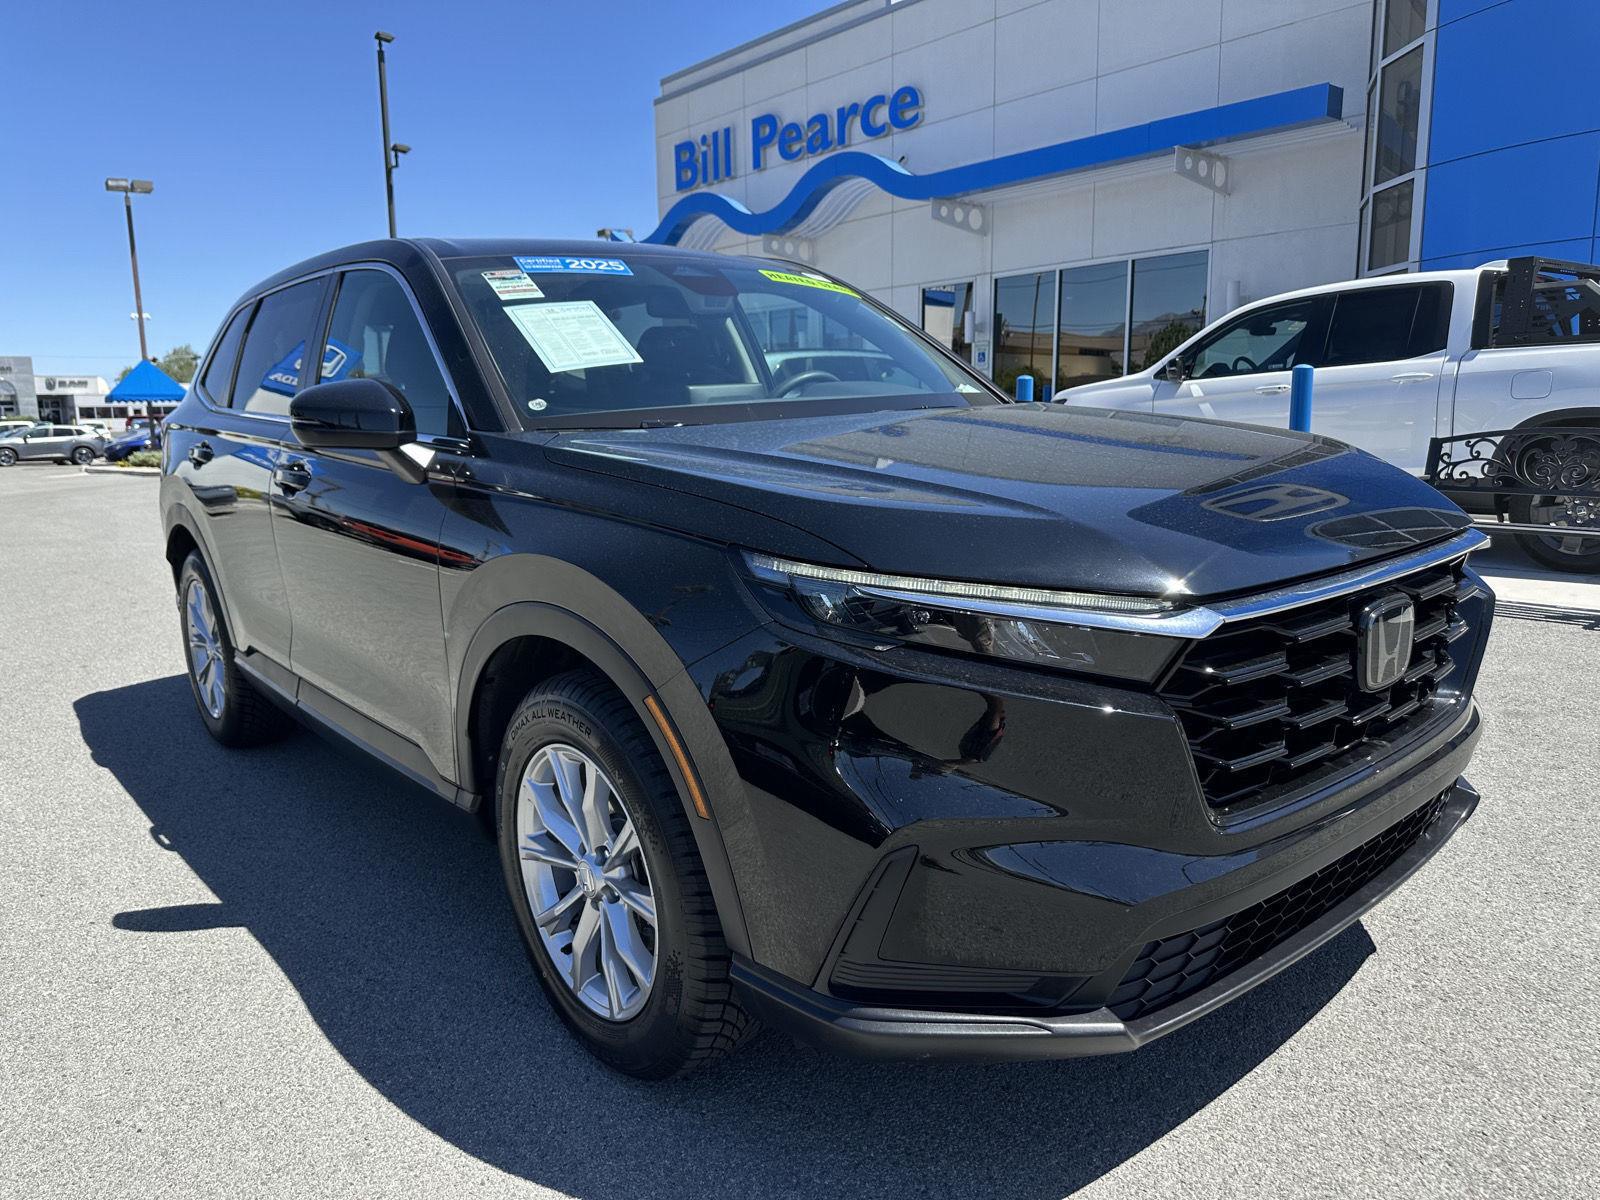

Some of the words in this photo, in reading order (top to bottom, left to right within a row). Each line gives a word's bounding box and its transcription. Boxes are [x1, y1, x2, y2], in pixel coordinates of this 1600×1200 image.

[674, 126, 734, 192] Bill
[752, 85, 921, 171] Pearce
[565, 258, 625, 271] 2025
[510, 713, 533, 740] DIMAX
[531, 708, 547, 720] ALL
[546, 707, 593, 740] WEATHER
